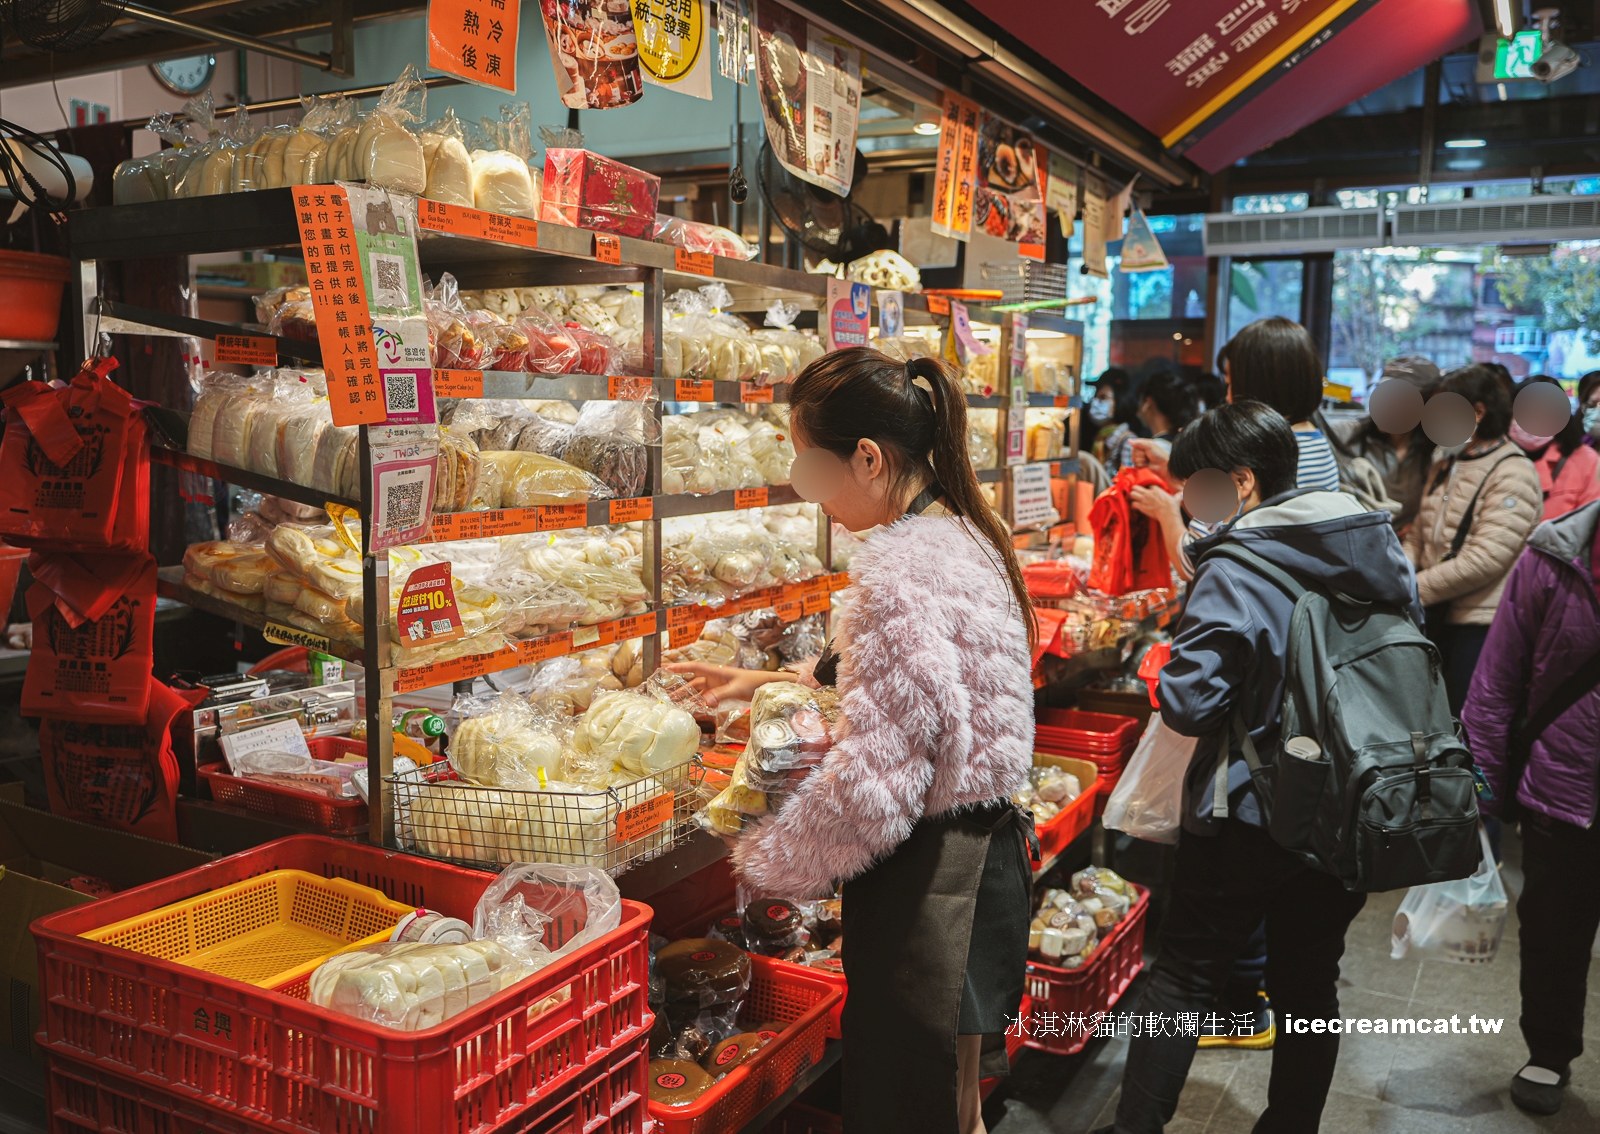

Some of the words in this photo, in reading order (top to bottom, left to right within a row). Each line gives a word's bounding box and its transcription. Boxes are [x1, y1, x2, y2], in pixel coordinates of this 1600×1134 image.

[635, 0, 691, 42] 統一發票
[404, 347, 426, 357] 悠遊付
[482, 510, 504, 523] 千層糕
[499, 521, 513, 529] Layered
[400, 678, 415, 686] Cheese
[625, 822, 635, 831] Plain
[644, 815, 654, 823] Cake
[193, 1007, 232, 1041] 合興
